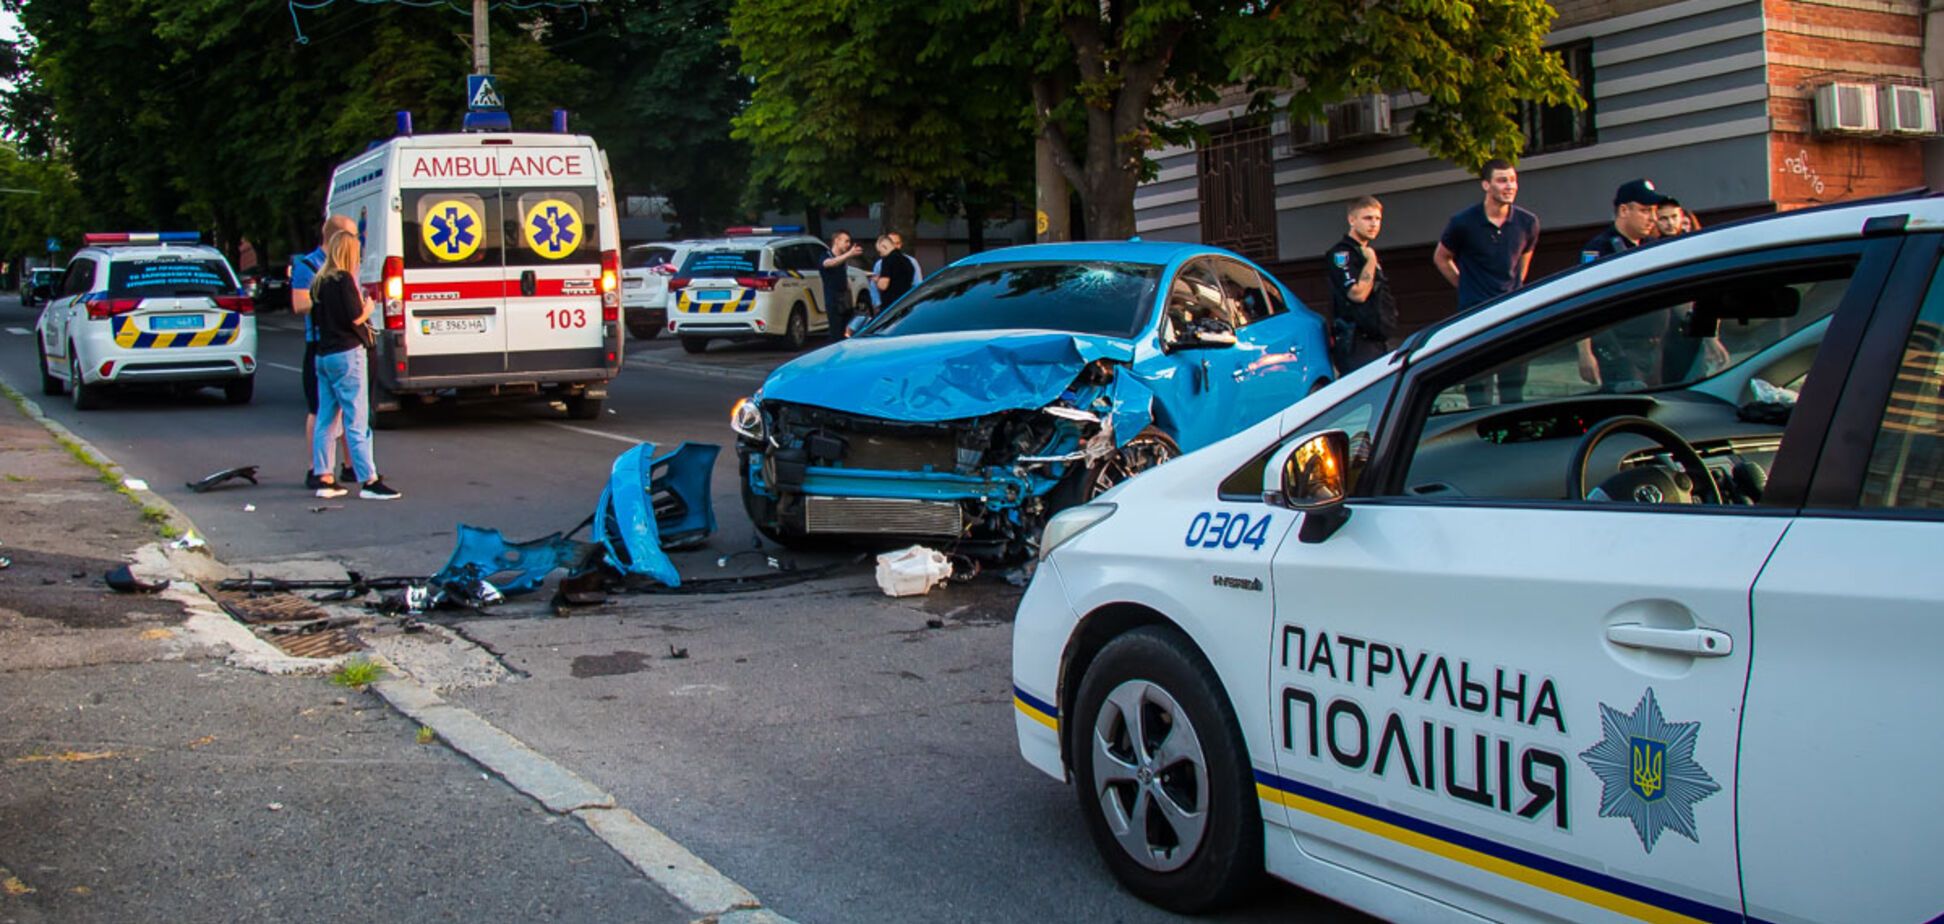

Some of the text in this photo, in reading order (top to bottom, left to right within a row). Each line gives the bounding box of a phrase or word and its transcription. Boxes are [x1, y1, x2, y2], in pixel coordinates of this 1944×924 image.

[412, 156, 583, 177] AMBULANCE
[546, 309, 587, 329] 103
[1185, 511, 1272, 551] 0304
[1281, 624, 1568, 734] ПАТРУЛЬНА
[1281, 686, 1570, 830] ПОЛІЦІЯ
